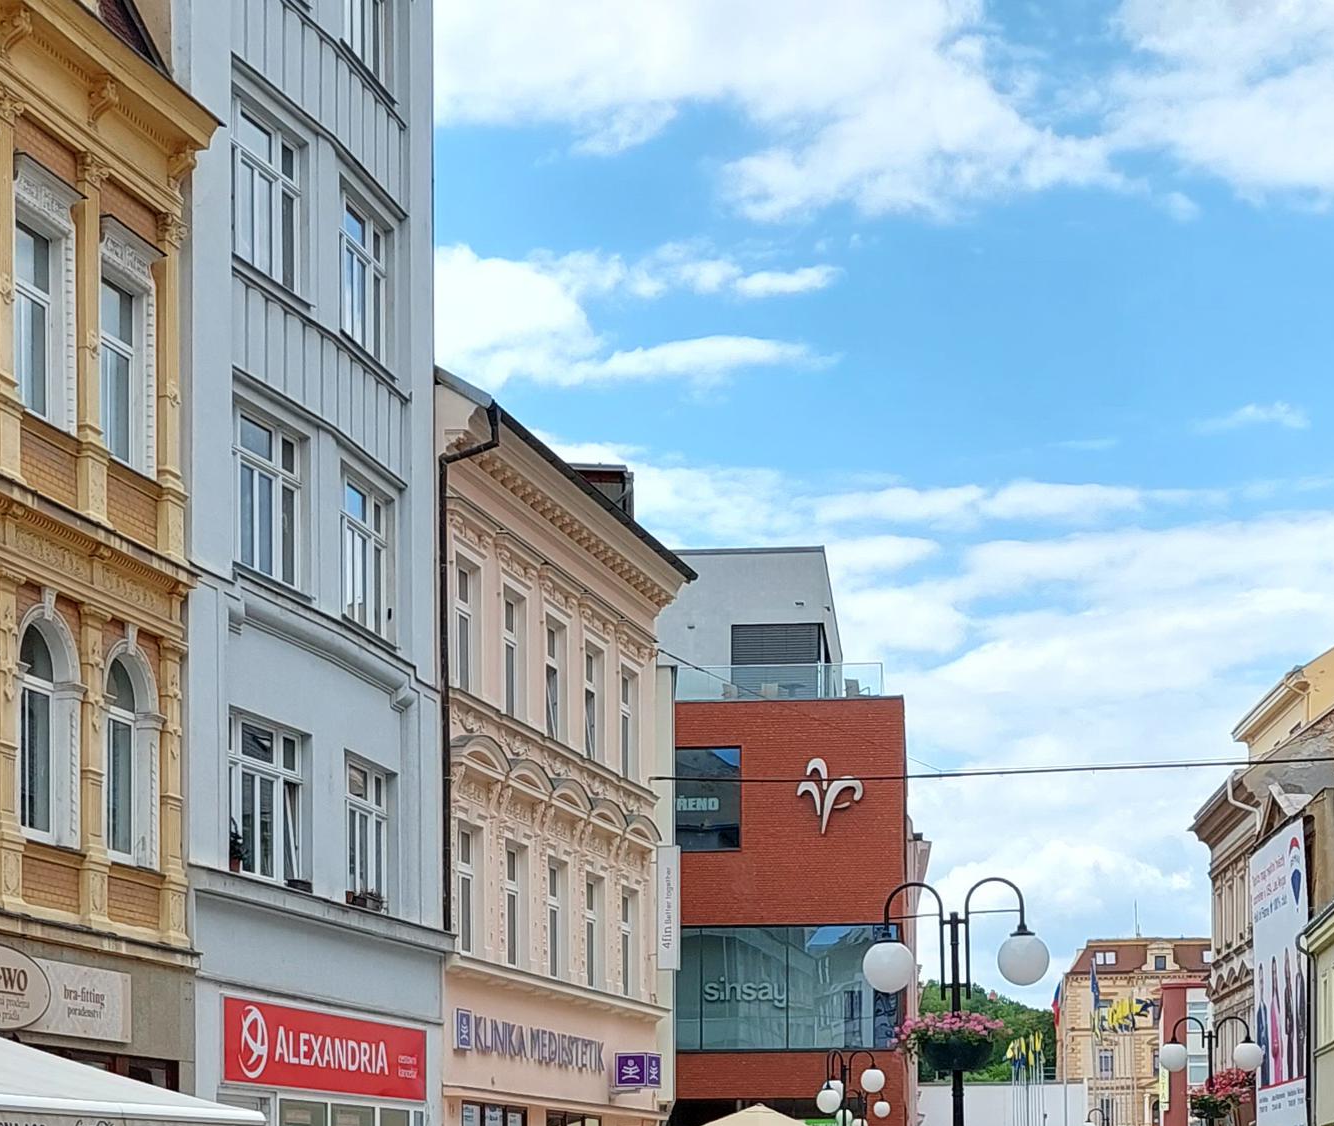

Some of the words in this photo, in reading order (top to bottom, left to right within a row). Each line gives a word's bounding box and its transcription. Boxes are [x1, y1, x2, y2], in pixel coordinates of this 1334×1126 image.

[63, 984, 106, 1009] bra-fitting
[704, 976, 787, 1008] sinsay
[275, 1025, 389, 1076] ALEXANDRIA
[474, 1015, 527, 1060] KLINIKA
